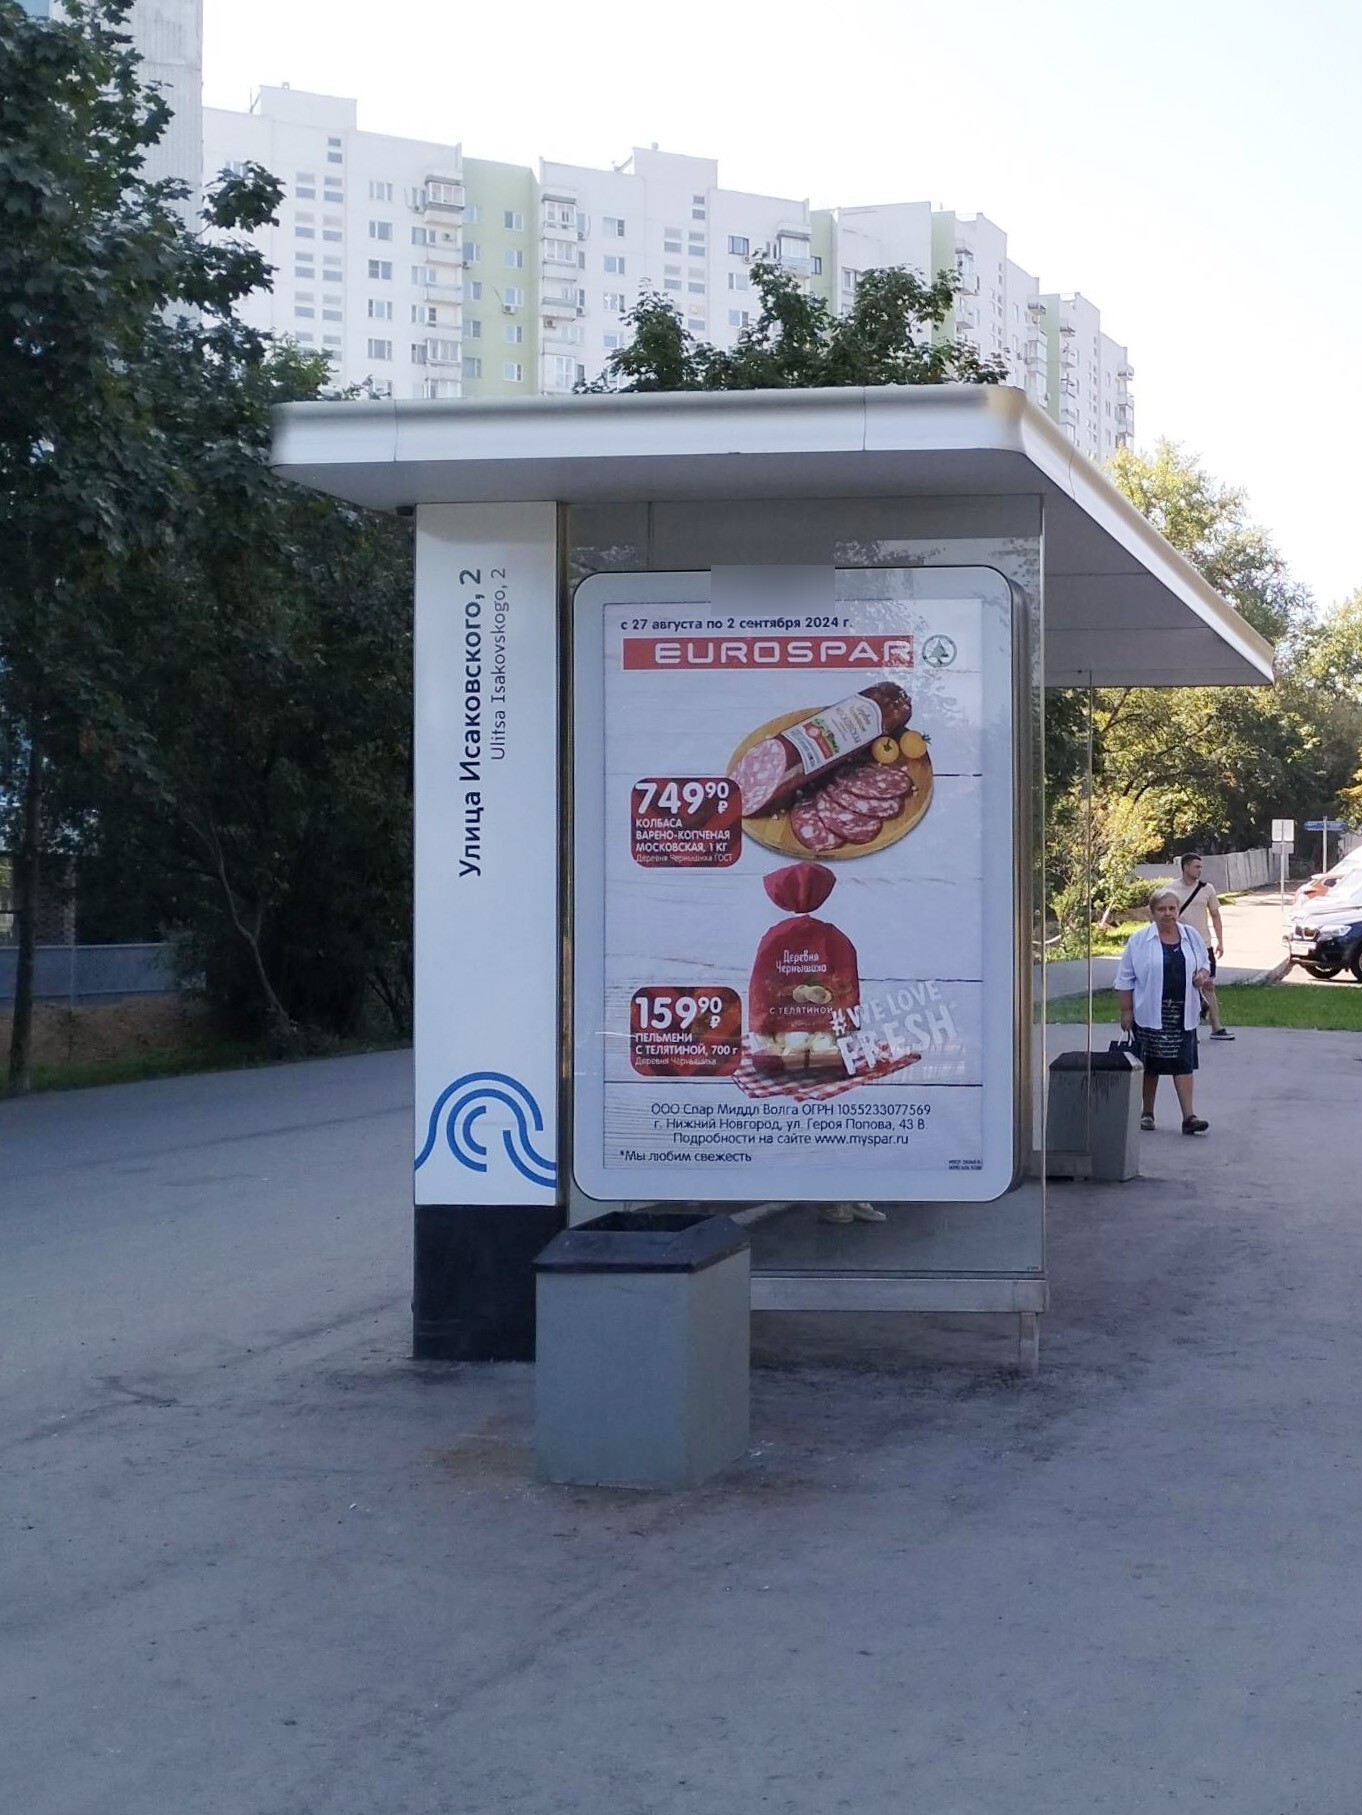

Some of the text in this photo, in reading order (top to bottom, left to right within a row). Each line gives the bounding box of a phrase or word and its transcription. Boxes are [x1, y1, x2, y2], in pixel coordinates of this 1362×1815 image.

[632, 618, 648, 630] 27
[652, 619, 703, 632] августа
[706, 619, 723, 629] по
[727, 618, 735, 629] 2
[739, 617, 801, 630] сентября
[805, 616, 839, 629] 2024
[843, 618, 853, 628] г.
[654, 640, 912, 664] EUROSPAR
[490, 567, 510, 761] Ulitsa Isakovskogo, 2
[458, 568, 485, 878] Улица Исаковского, 2
[635, 781, 705, 815] 749
[705, 782, 730, 799] 90
[635, 817, 683, 829] КОЛБАСА
[635, 830, 731, 841] ВАРЕНО-КОПЧЕНАЯ
[635, 842, 728, 853] МОСКОВСКАЯ, 1 КГ
[714, 853, 733, 862] ГОСТ
[783, 949, 819, 963] Деревня
[886, 980, 942, 1016] LOVE
[635, 996, 698, 1030] 159
[698, 996, 723, 1014] 90
[635, 1032, 693, 1043] ПЕЛЬМЕНИ
[635, 1045, 643, 1055] С
[646, 1043, 709, 1057] ТЕЛЯТИНОЙ,
[711, 1045, 731, 1056] 700
[651, 1102, 931, 1117] ООО Спар Миддл Волга ОГРН 1055233077569
[666, 1118, 716, 1130] Нижний
[719, 1118, 783, 1131] Новгород,
[807, 1118, 842, 1131] Героя
[845, 1118, 895, 1131] Попова,
[898, 1118, 914, 1130] 43
[673, 1132, 909, 1146] Подробности на сайте www.myspar.ru
[648, 1149, 692, 1162] любим
[694, 1152, 752, 1163] свежесть
